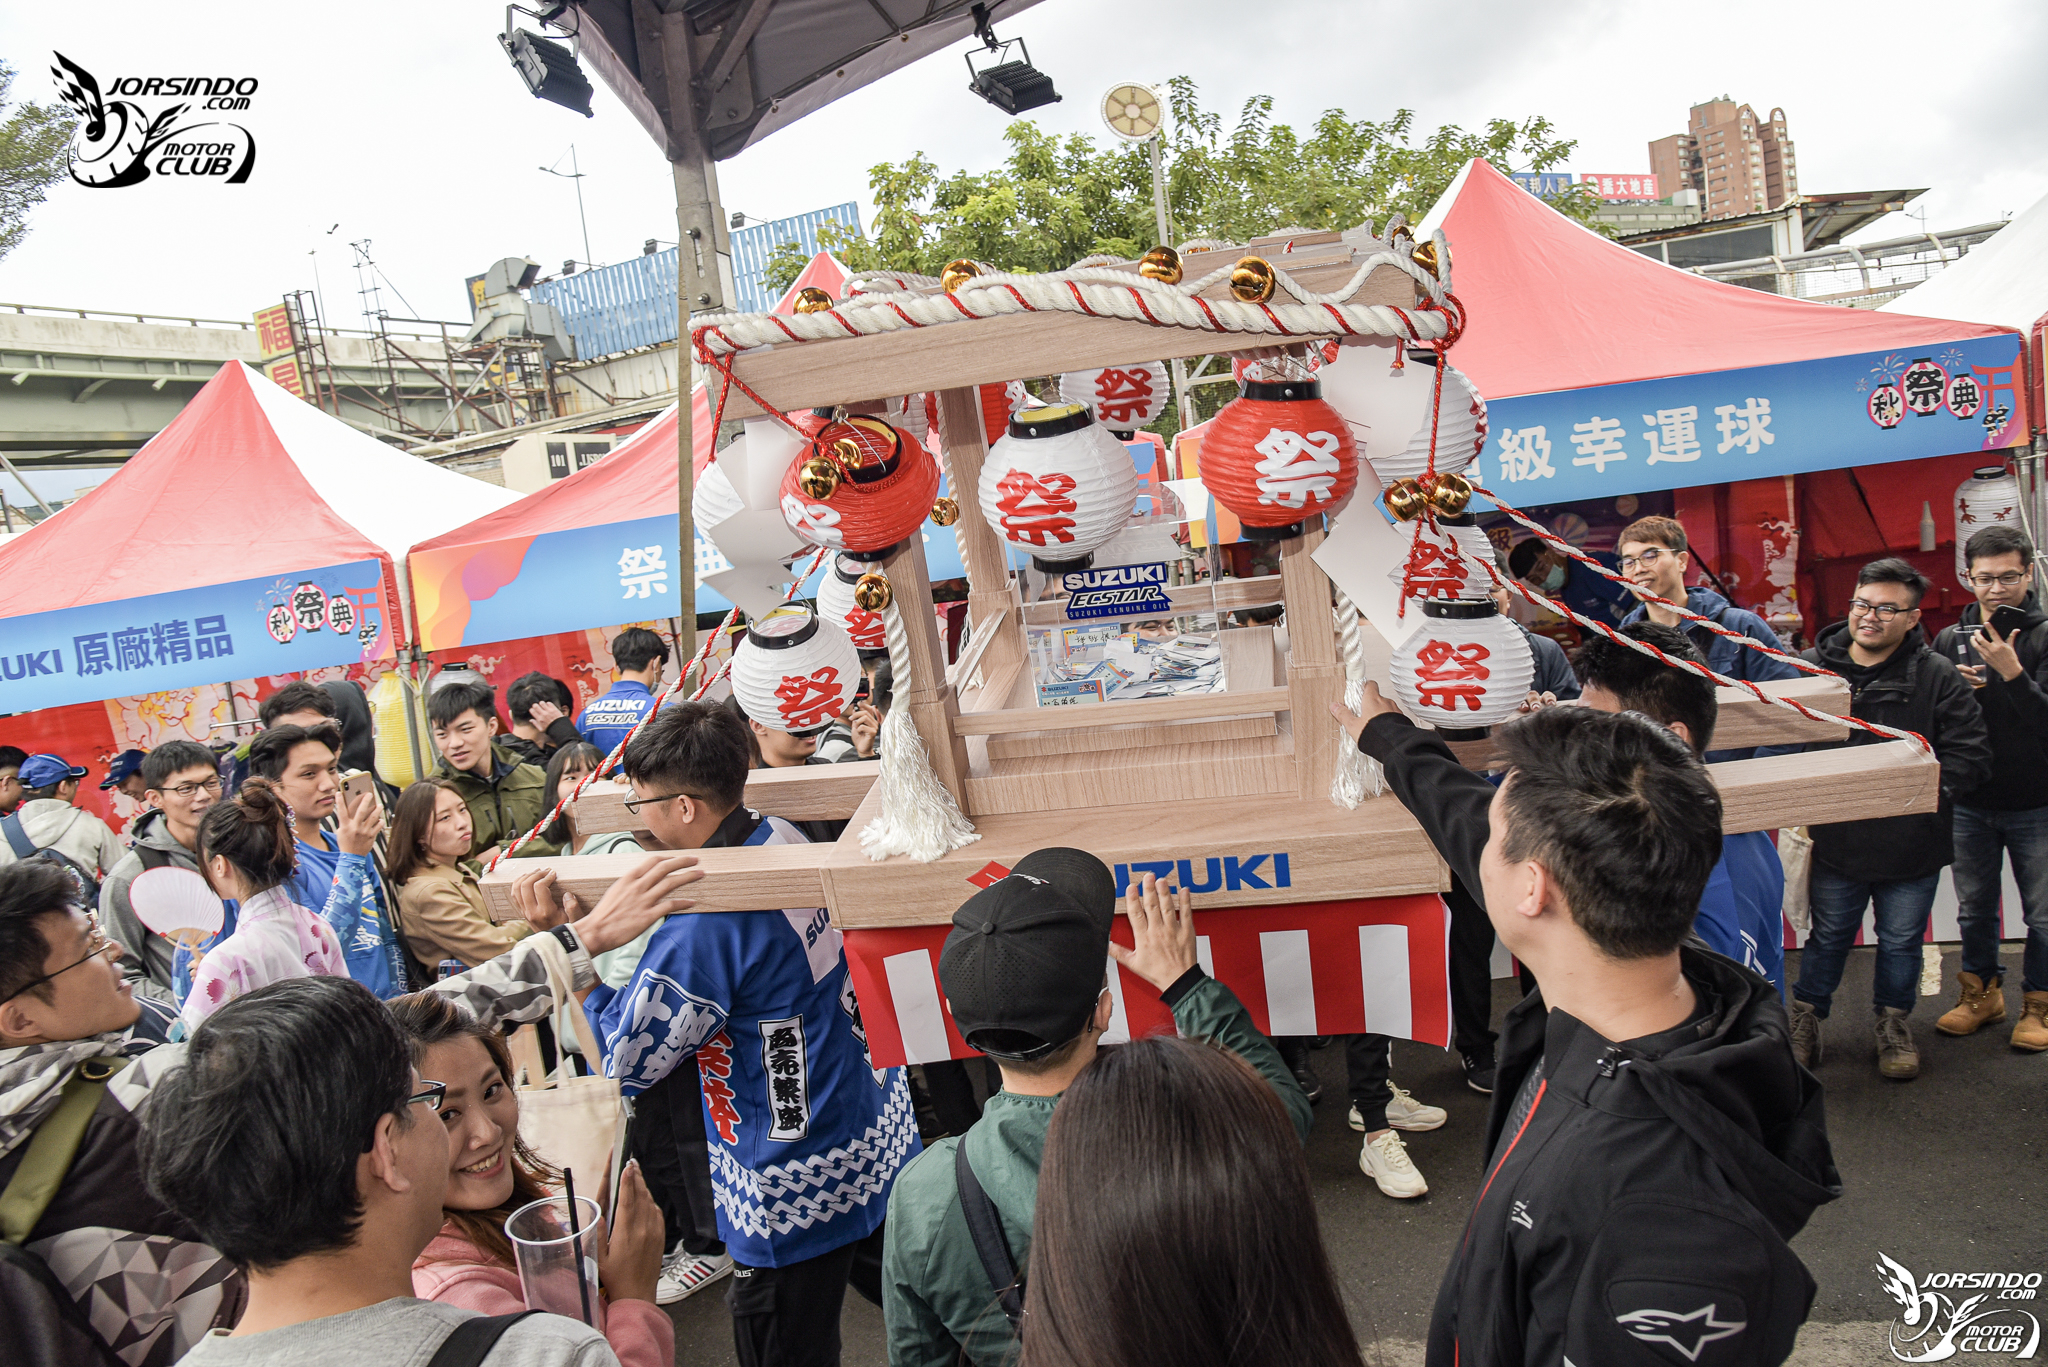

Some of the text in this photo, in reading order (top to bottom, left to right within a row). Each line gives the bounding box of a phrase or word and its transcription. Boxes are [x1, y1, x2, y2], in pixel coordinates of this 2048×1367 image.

[1094, 367, 1153, 421] 祭
[1872, 369, 1979, 420] 秋祭典
[550, 454, 566, 467] 101
[1253, 427, 1340, 508] 祭
[1462, 397, 1776, 488] 級幸運球
[995, 467, 1078, 546] 祭
[1065, 565, 1165, 590] SUZUKI
[1070, 585, 1165, 609] ECSTAR
[270, 589, 353, 636] 秋祭典
[1070, 602, 1168, 618] SUZUKI GENUINE OIL
[0, 614, 234, 681] UKI 原廠精品
[773, 666, 844, 728] 祭
[1414, 639, 1490, 711] 祭
[585, 699, 646, 714] SUZUKI
[585, 712, 640, 726] ECSTAR
